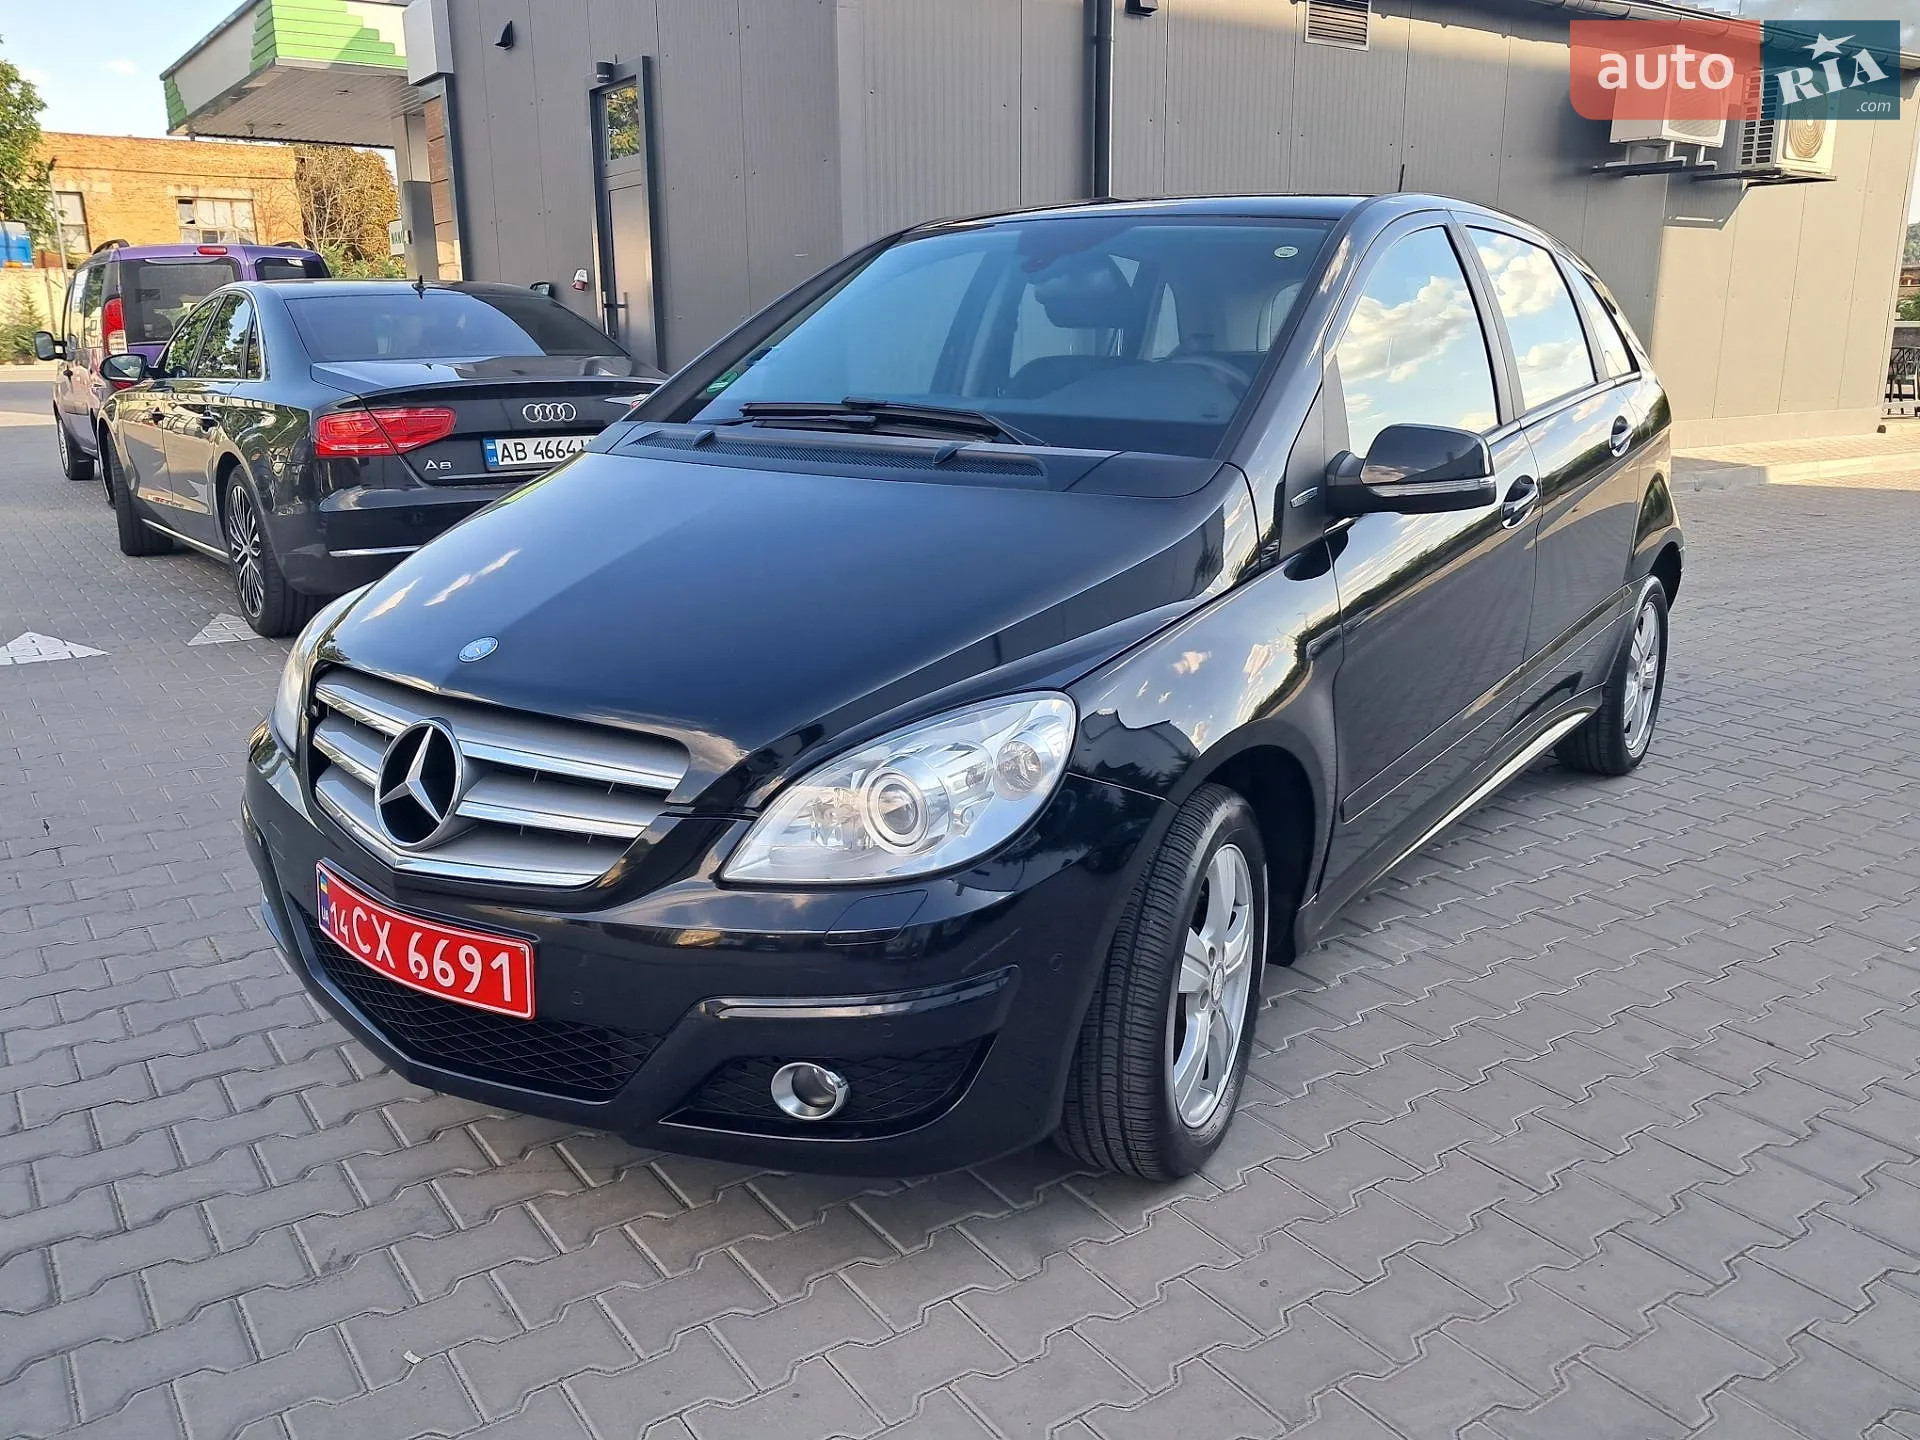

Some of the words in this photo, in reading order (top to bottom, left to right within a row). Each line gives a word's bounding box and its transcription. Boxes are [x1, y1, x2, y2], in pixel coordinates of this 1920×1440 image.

[501, 442, 528, 463] AB
[424, 459, 452, 471] A8
[408, 931, 512, 1003] 6691
